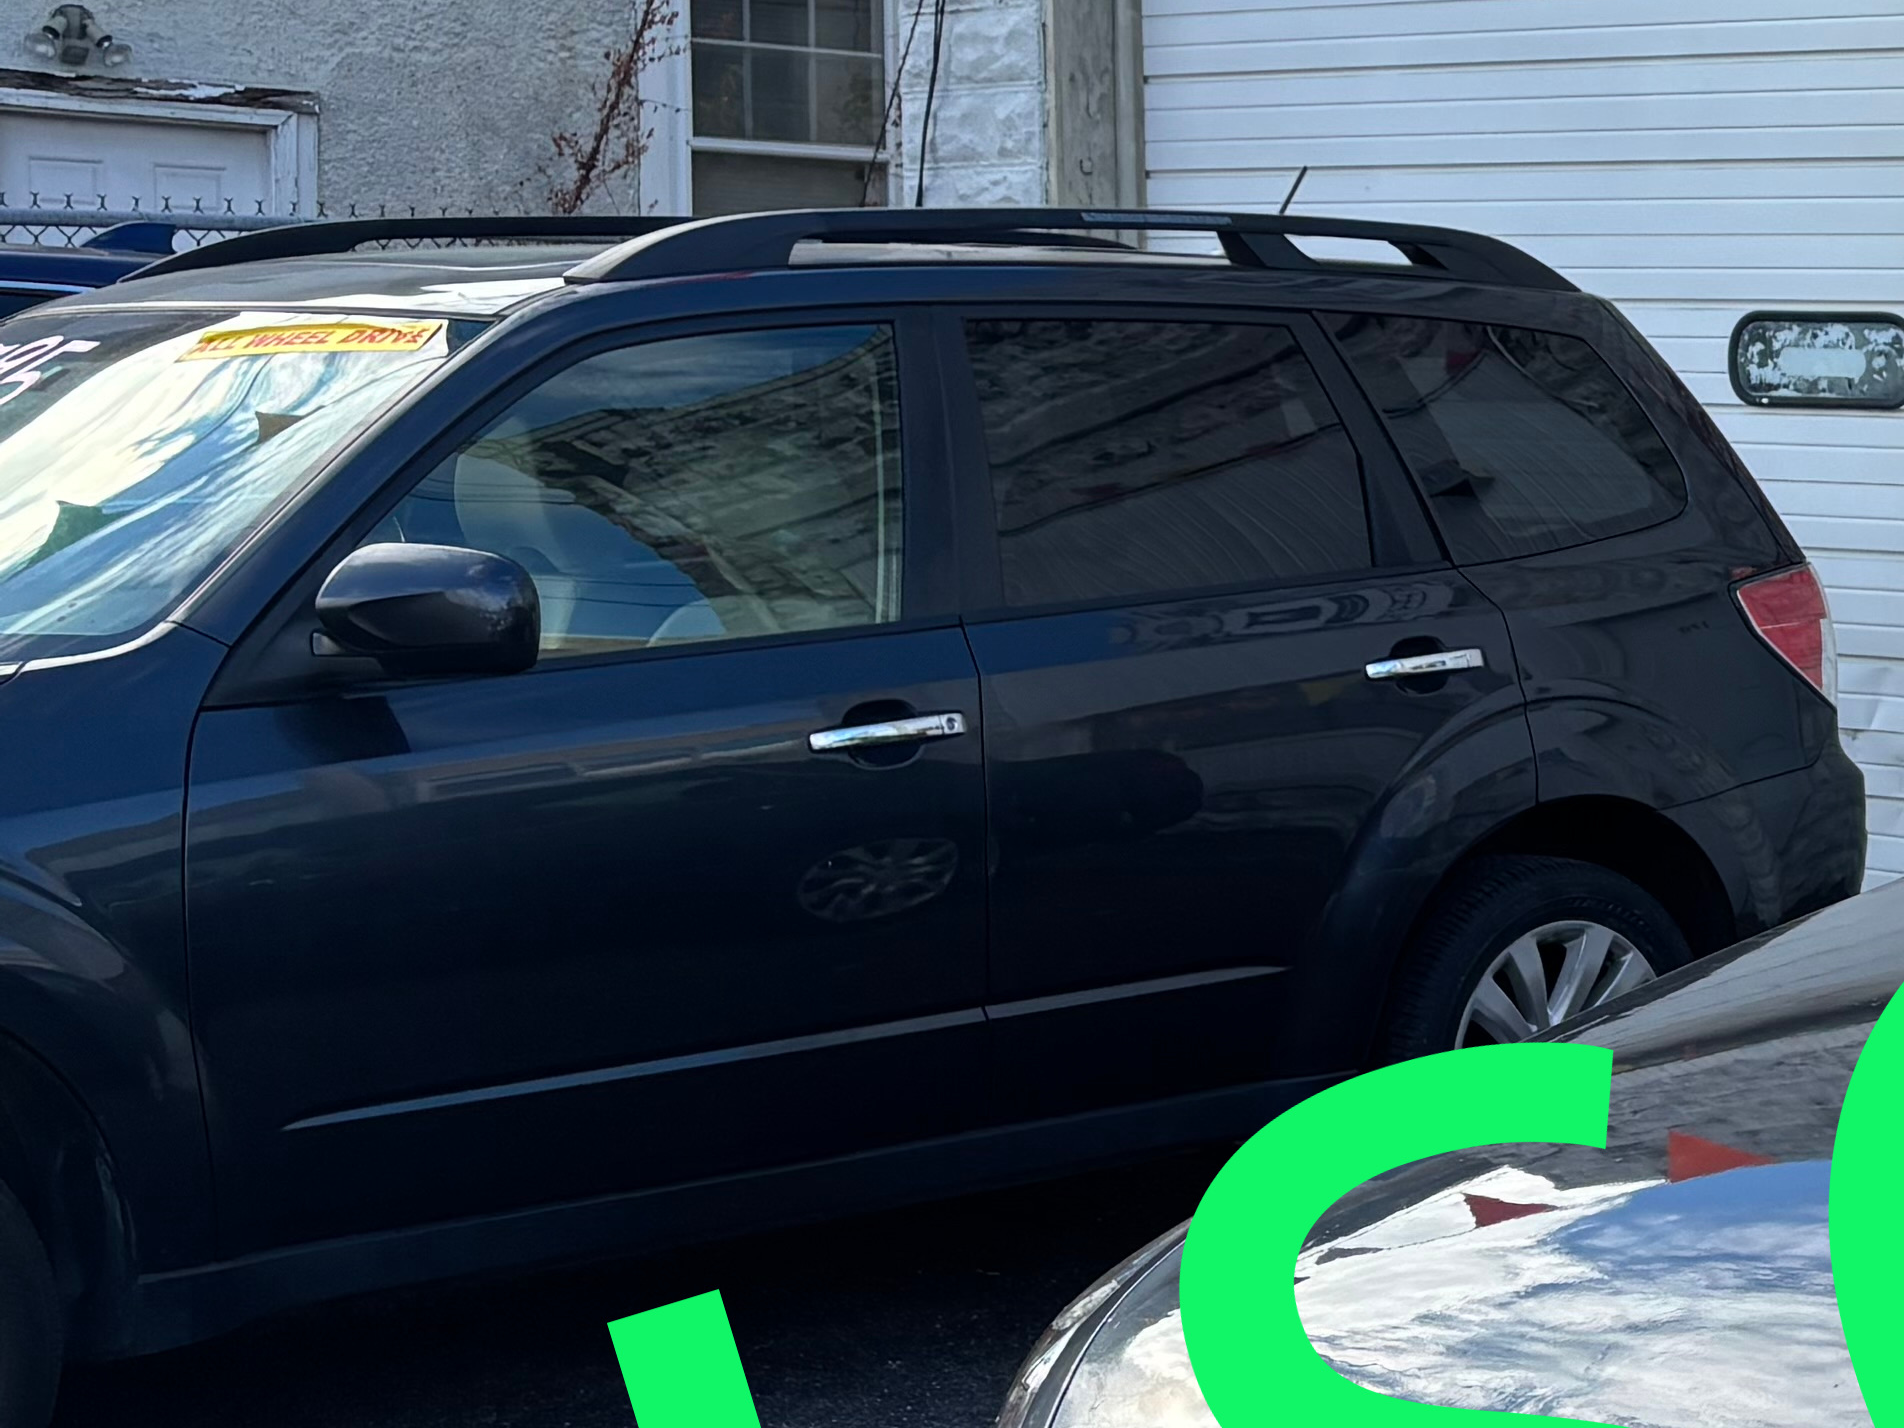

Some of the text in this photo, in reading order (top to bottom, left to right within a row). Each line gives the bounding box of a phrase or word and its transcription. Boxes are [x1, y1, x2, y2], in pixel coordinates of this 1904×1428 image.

[197, 328, 430, 352] ALL WHEEL DRIVE
